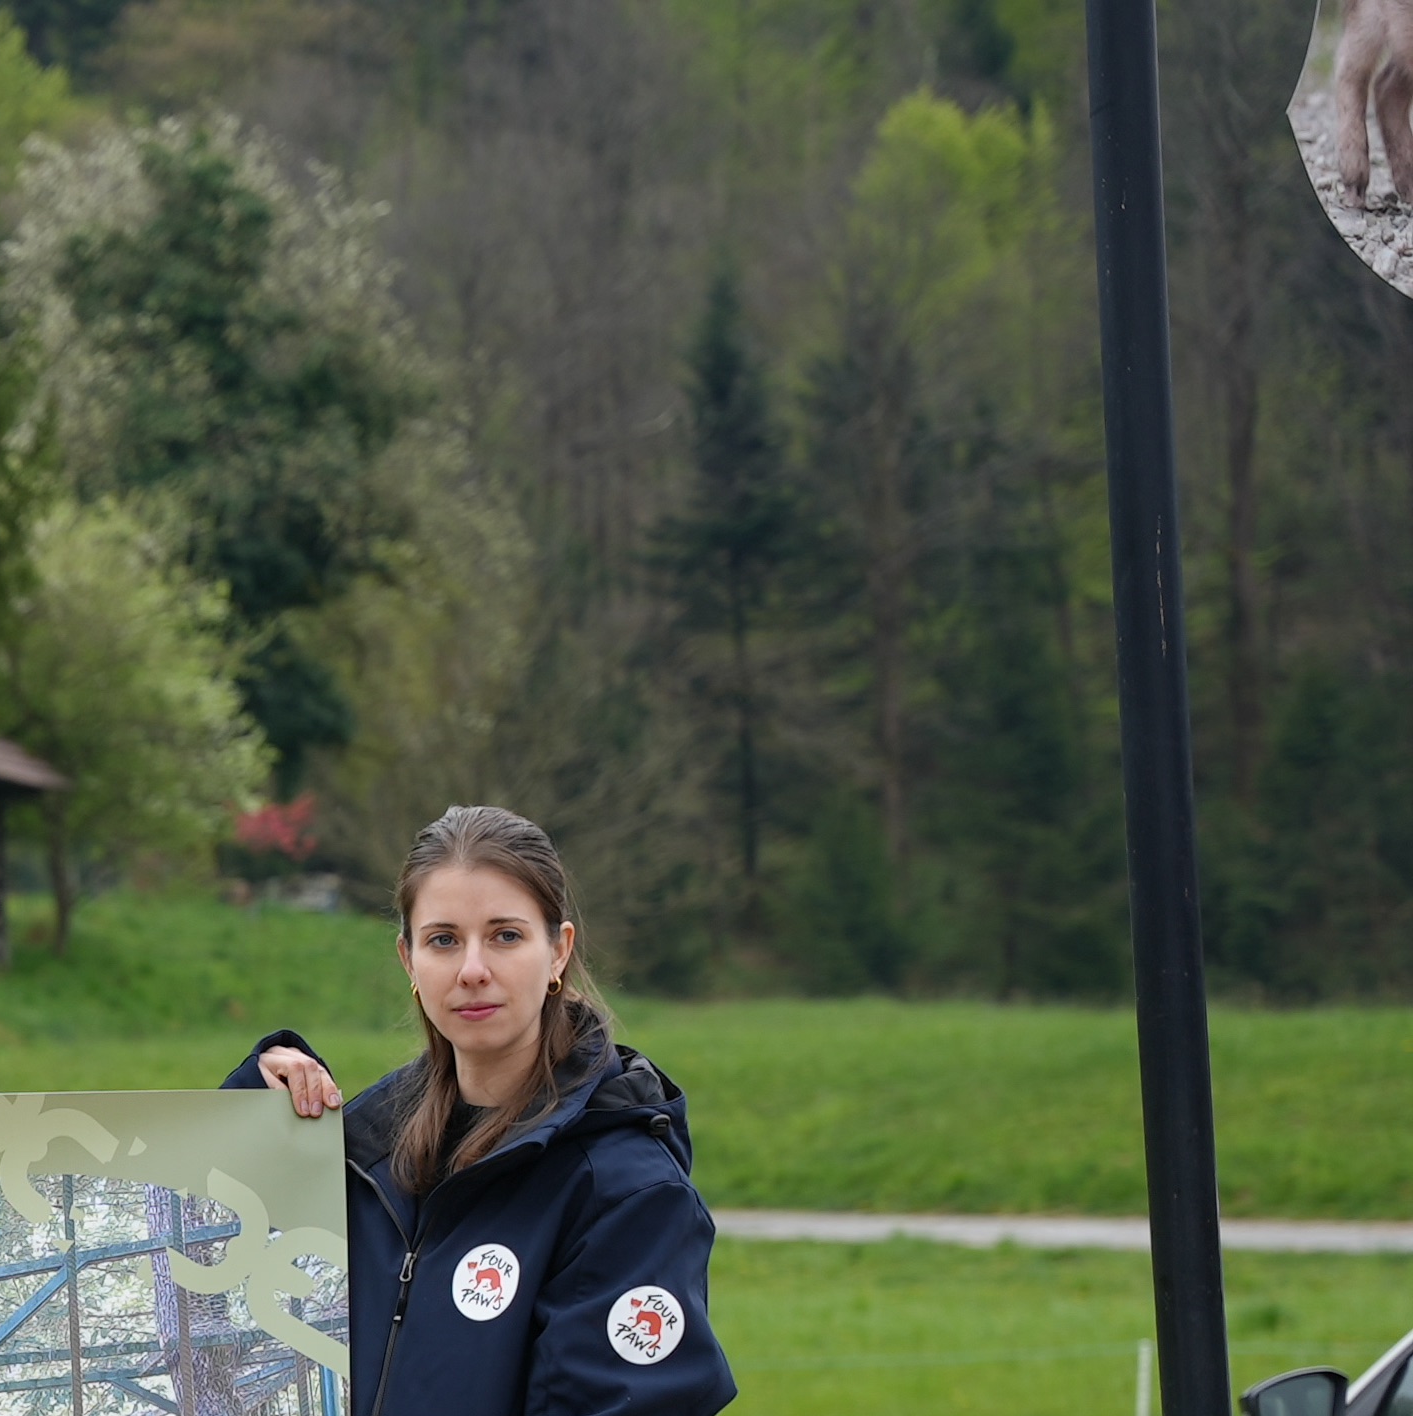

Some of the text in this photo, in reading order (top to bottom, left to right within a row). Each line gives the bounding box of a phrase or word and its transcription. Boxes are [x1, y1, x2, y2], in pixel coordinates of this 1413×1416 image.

[479, 1250, 513, 1279] FOUR
[460, 1288, 503, 1311] PAWS
[643, 1294, 678, 1330] FOUR
[614, 1323, 661, 1358] PAWS
